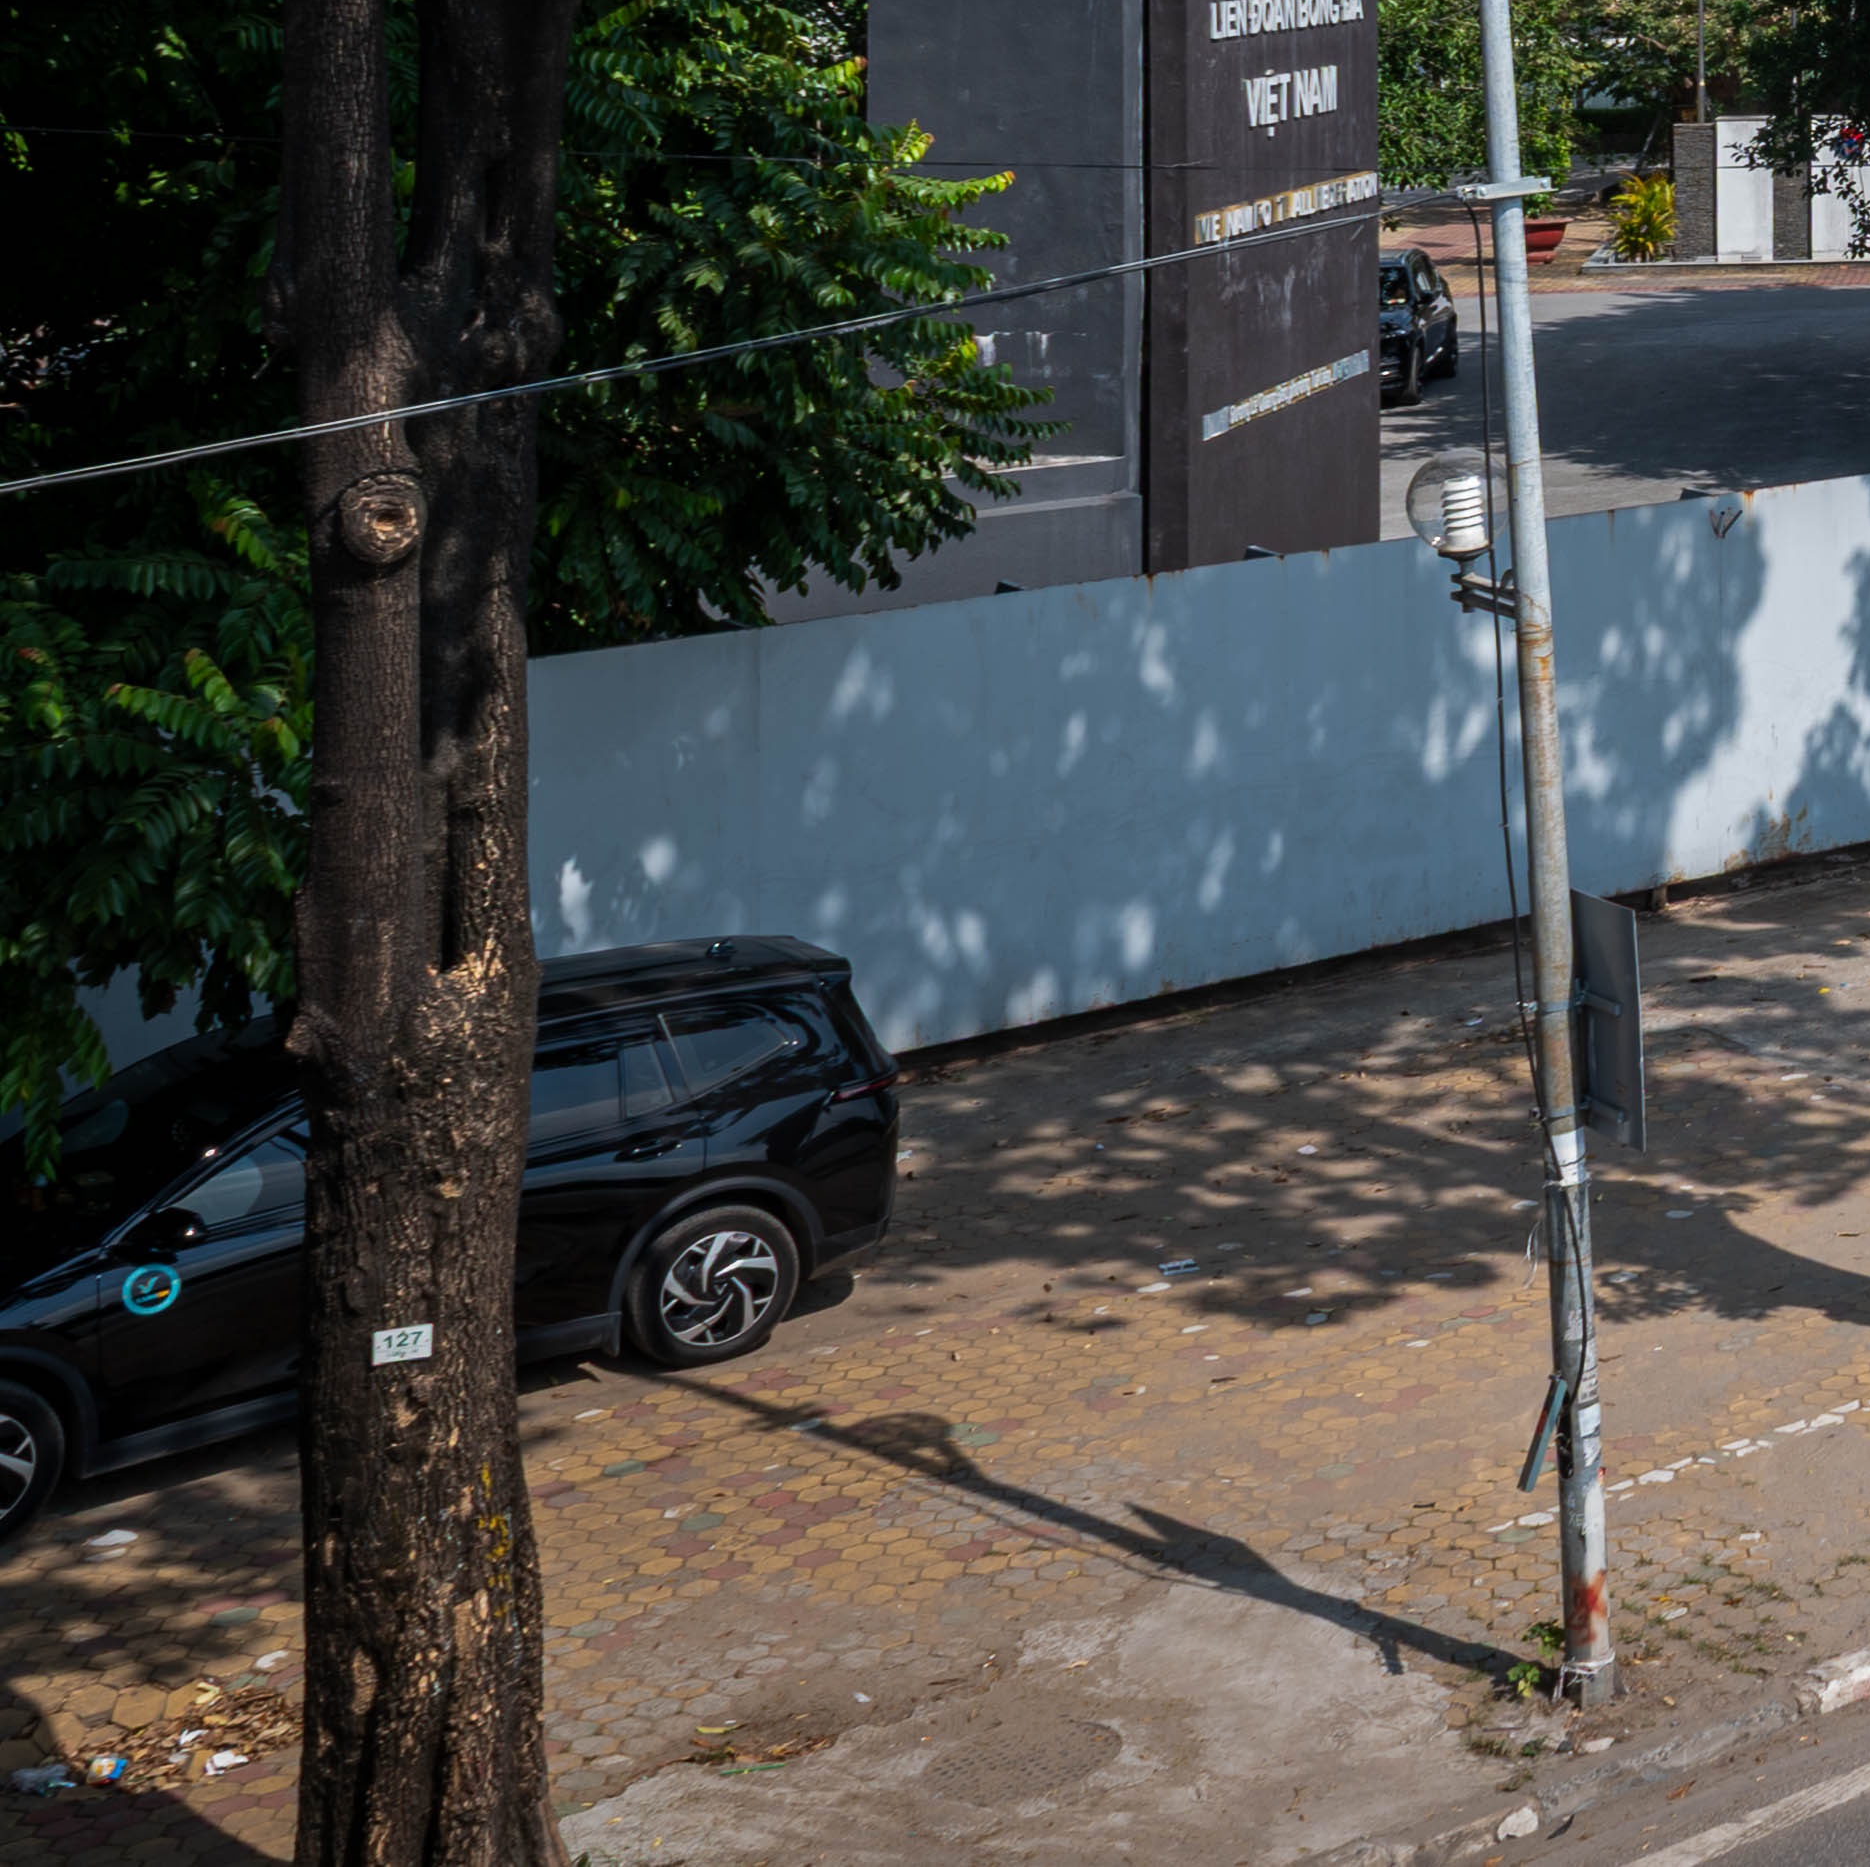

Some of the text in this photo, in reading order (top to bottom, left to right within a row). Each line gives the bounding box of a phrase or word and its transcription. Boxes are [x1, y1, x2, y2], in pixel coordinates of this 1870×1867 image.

[1243, 65, 1338, 138] VIỆT NAM
[383, 1331, 424, 1348] 127
